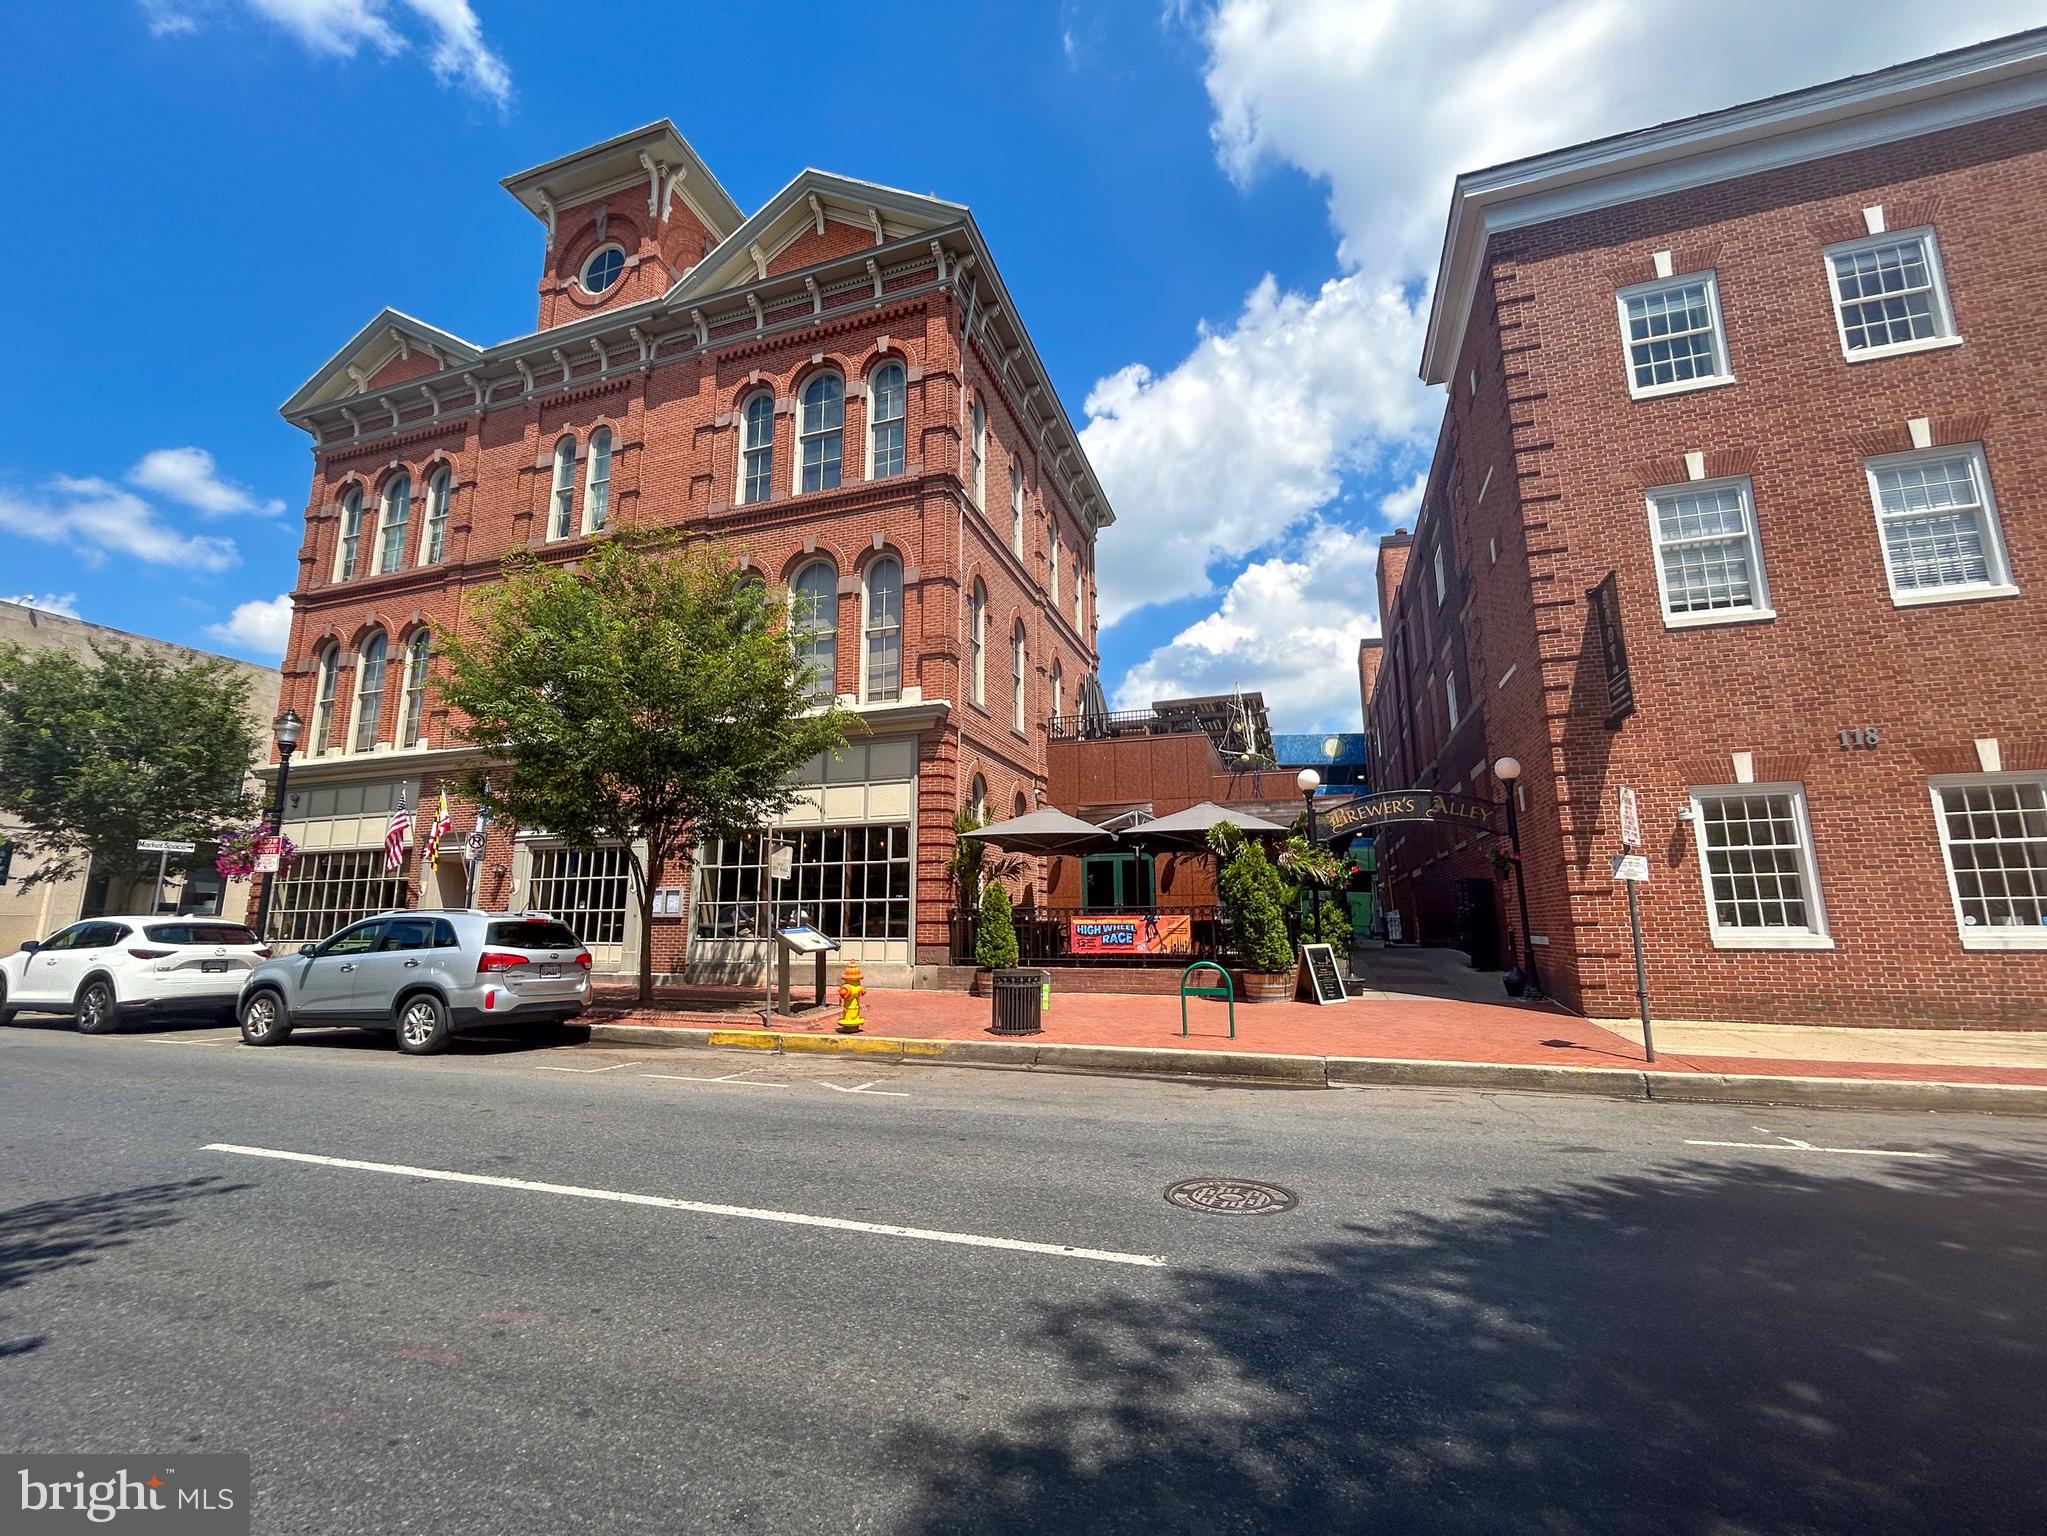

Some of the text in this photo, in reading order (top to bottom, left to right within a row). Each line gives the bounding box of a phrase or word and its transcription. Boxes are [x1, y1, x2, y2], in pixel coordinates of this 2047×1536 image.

[1839, 726, 1880, 746] 118
[1425, 795, 1494, 822] ALLEY
[139, 840, 187, 850] Market Space
[1077, 924, 1137, 935] HIGH WHEEL
[1102, 932, 1133, 944] RACE
